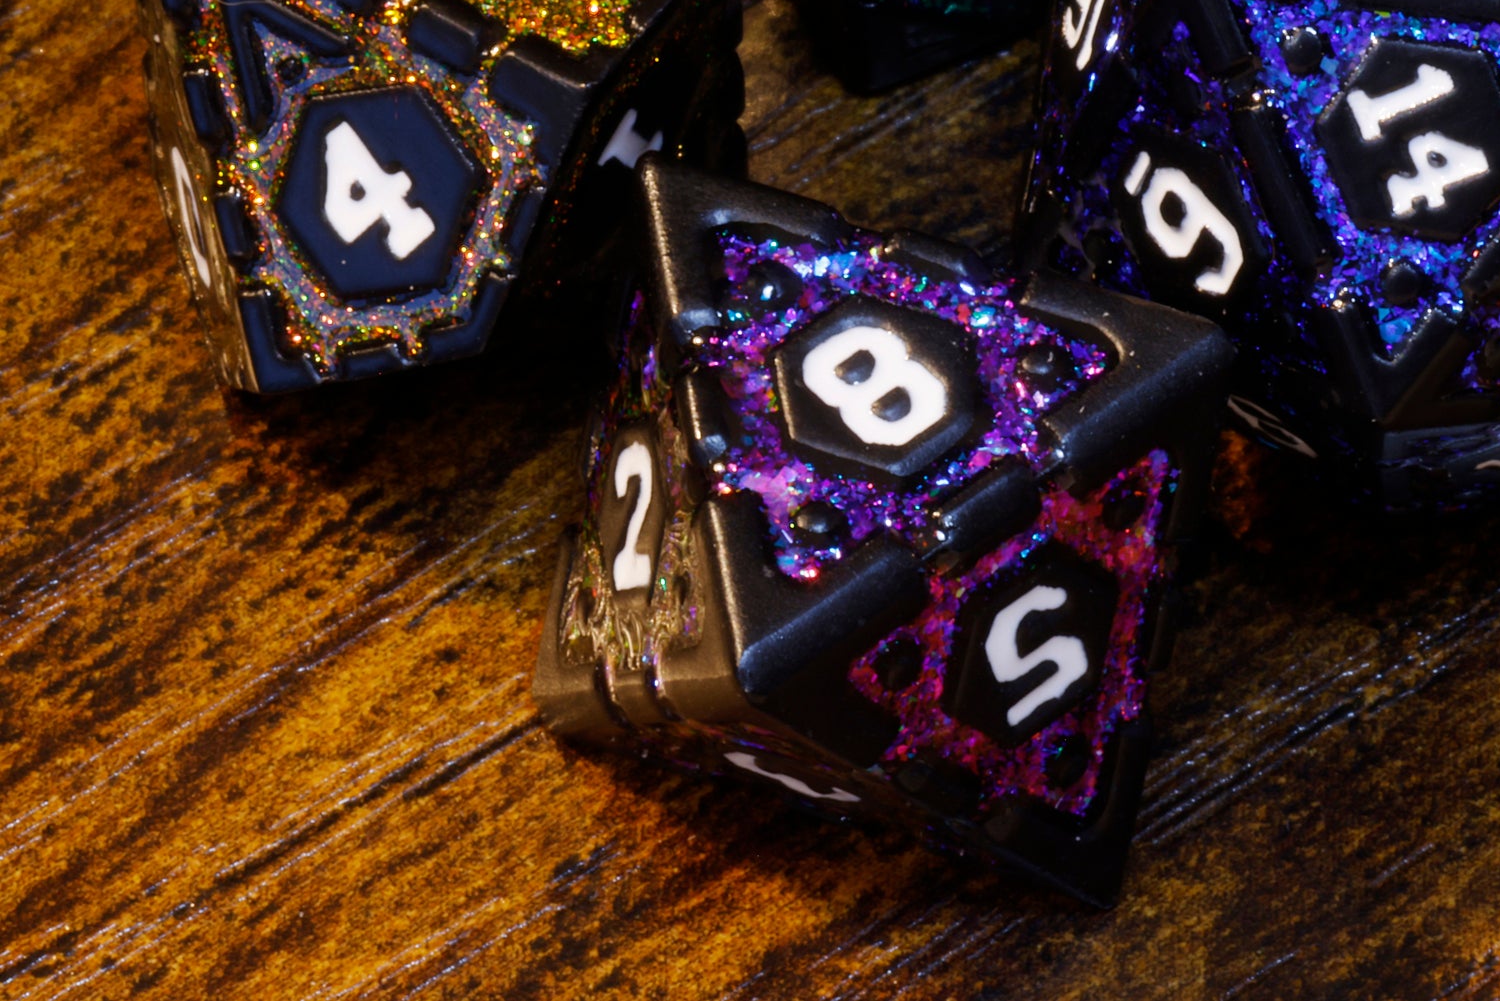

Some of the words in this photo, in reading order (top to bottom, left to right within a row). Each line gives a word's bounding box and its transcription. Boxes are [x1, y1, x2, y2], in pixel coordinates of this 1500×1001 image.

[325, 122, 435, 258] 4
[1347, 64, 1489, 216] 14
[1125, 152, 1243, 294] 6
[801, 325, 948, 446] 8
[613, 441, 652, 591] 2
[985, 586, 1087, 725] 5
